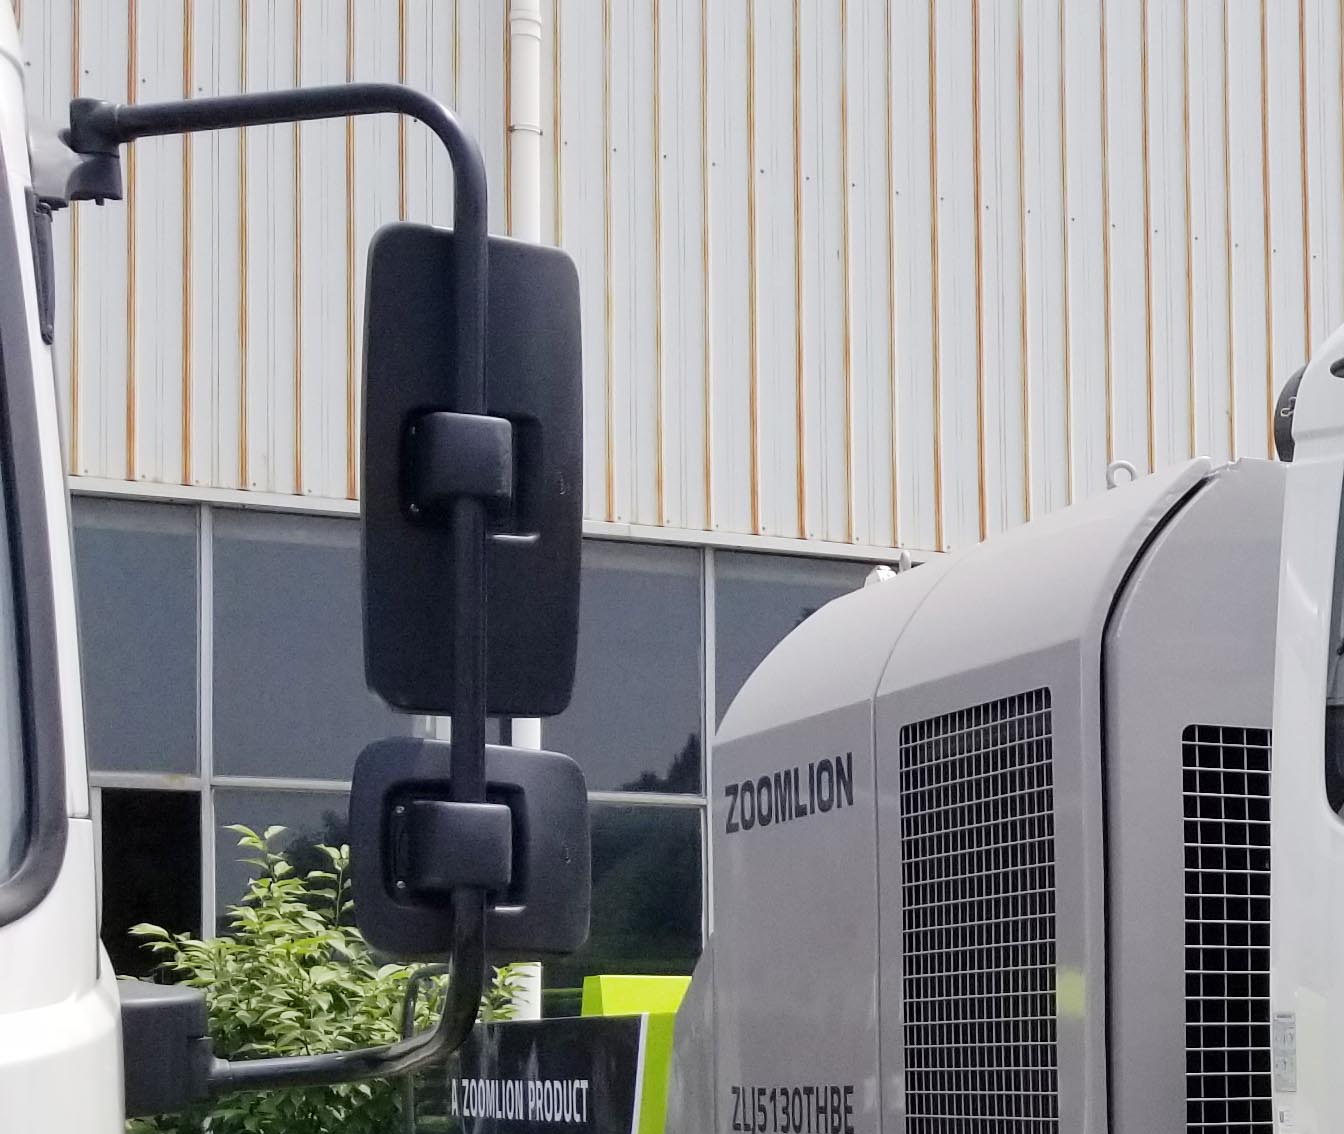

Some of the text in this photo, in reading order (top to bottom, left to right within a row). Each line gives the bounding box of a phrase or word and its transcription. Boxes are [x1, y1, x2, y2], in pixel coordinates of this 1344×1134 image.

[725, 752, 854, 834] ZOOMLION
[451, 1078, 589, 1123] A ZOOMLION PRODUCT
[731, 1085, 855, 1134] ZLJ5130THBE
